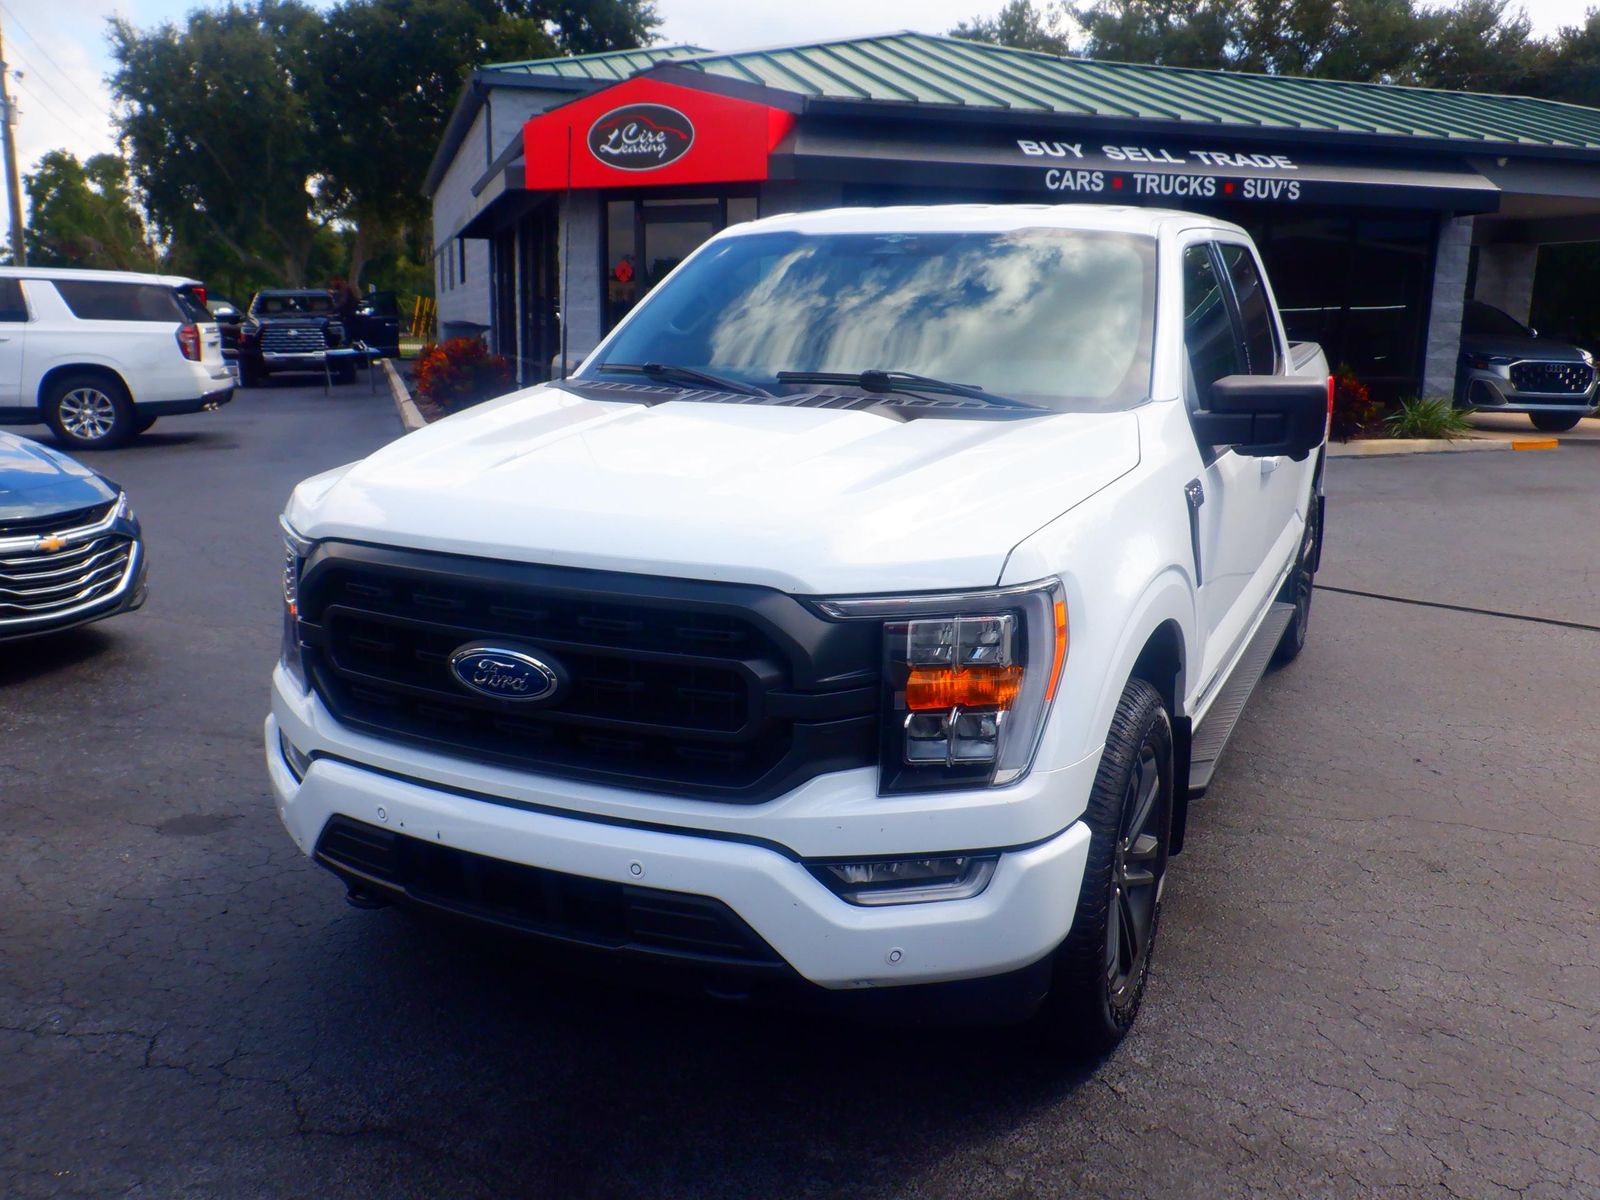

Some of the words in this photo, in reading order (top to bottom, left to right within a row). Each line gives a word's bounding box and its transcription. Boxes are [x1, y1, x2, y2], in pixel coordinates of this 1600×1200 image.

[600, 129, 667, 158] Leasing
[622, 123, 666, 144] Cire
[1017, 140, 1084, 158] BUY
[1102, 145, 1186, 164] SELL
[1189, 150, 1298, 170] TRADE
[1045, 169, 1104, 192] CARS
[1133, 173, 1216, 197] TRUCKS
[1243, 179, 1300, 200] SUV'S
[474, 659, 528, 691] Ford
